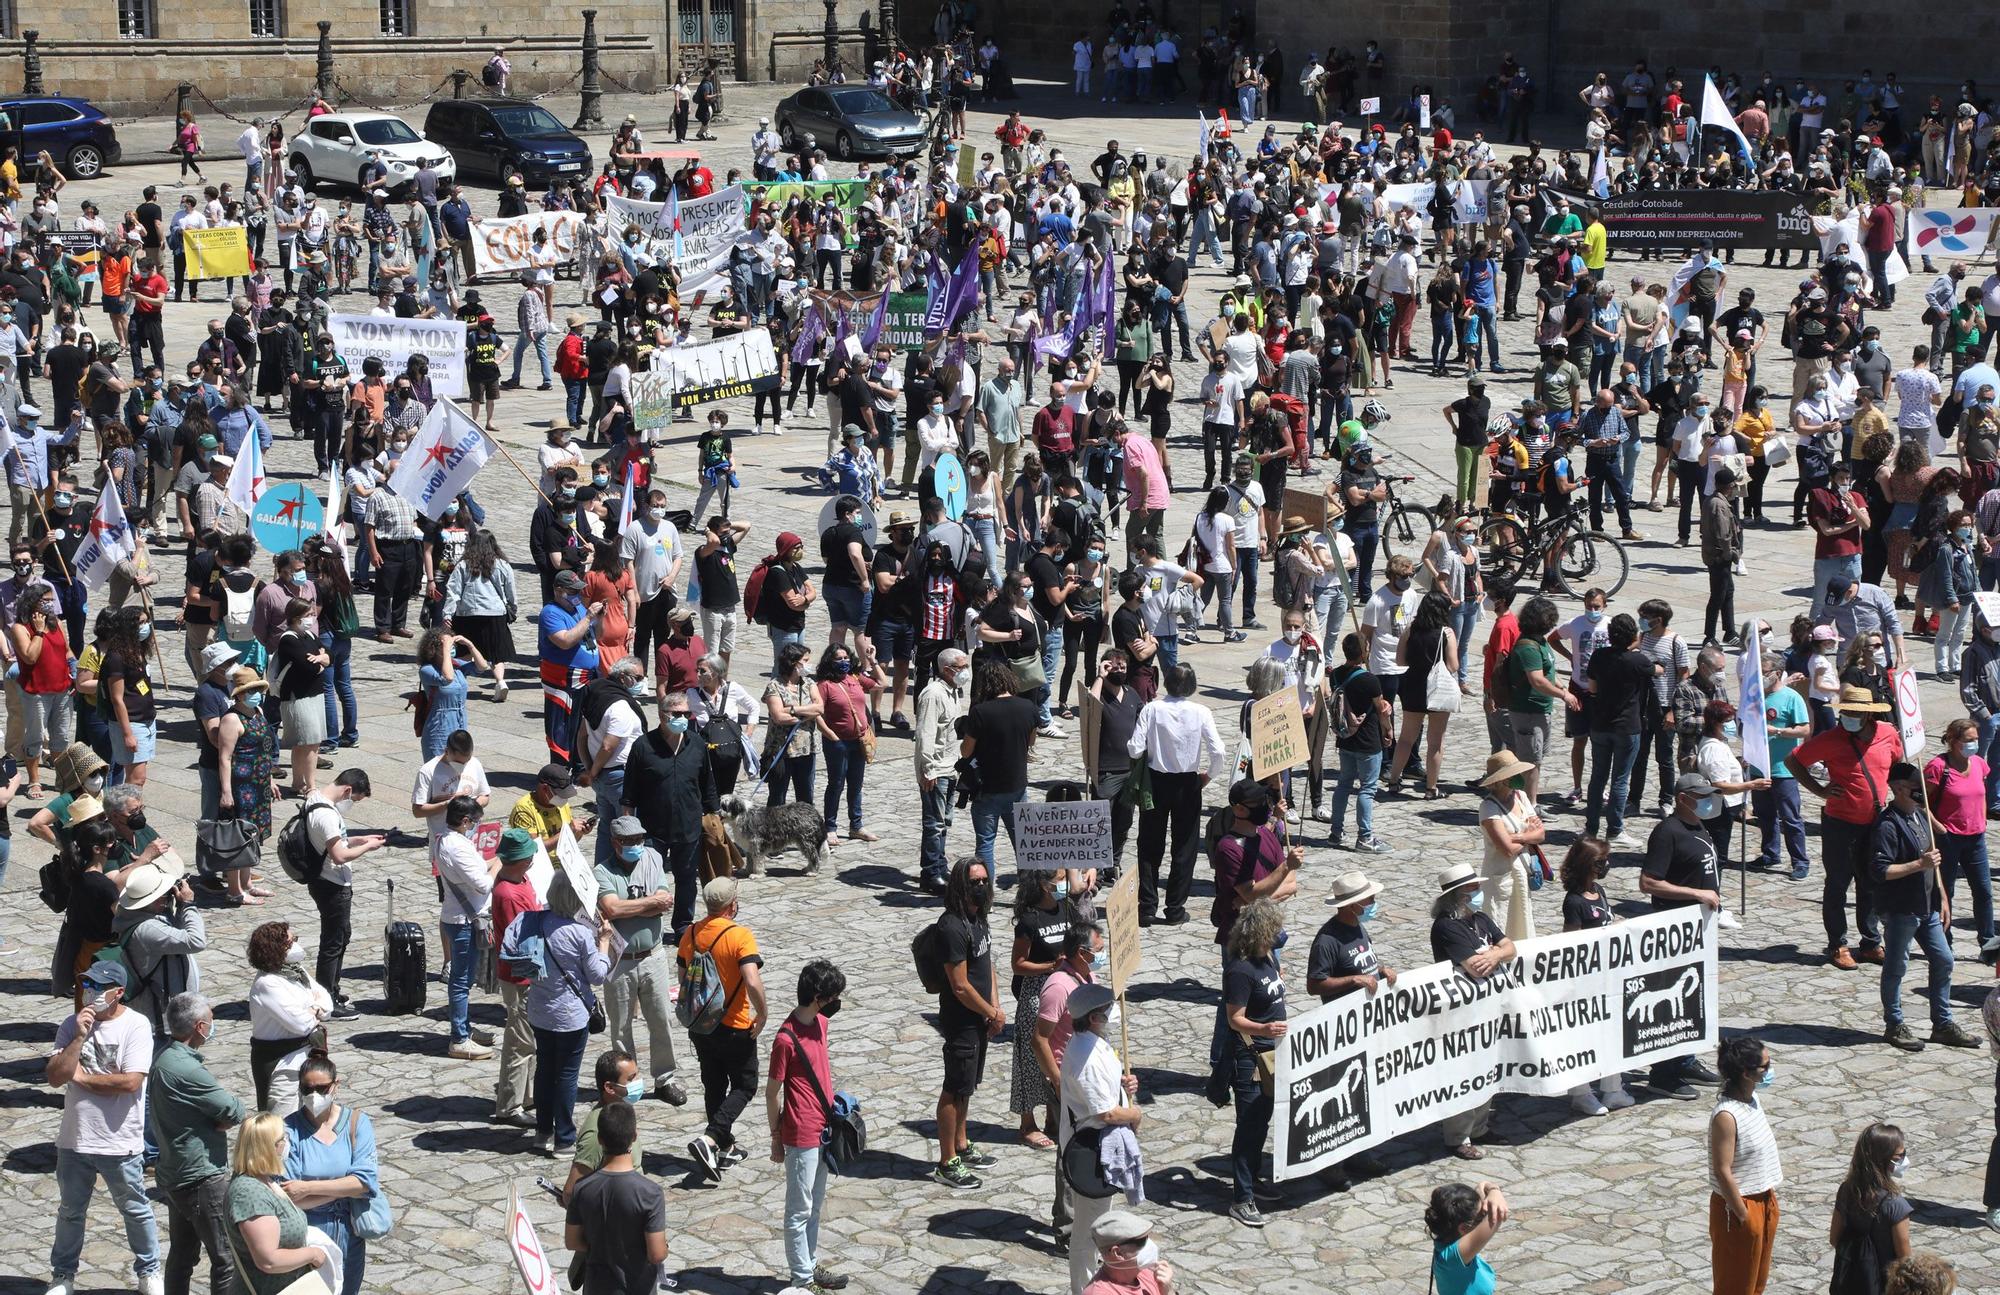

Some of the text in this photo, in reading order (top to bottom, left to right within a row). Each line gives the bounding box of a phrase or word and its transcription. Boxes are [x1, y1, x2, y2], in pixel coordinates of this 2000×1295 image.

[682, 200, 737, 222] PRESENTE
[1465, 204, 1487, 217] bng
[692, 218, 730, 237] ALDEAS
[1776, 212, 1810, 235] bng
[1619, 230, 1657, 239] ESPOLIO,
[1659, 230, 1675, 238] NIN
[885, 313, 899, 326] DA
[904, 313, 925, 326] TER
[344, 320, 458, 350] NON NON
[878, 331, 925, 344] ENOVAB
[344, 345, 391, 359] EÓLICOS
[425, 349, 456, 358] TENSIÓN
[476, 343, 495, 352] NON
[430, 362, 447, 370] OSA
[681, 393, 699, 406] NON
[714, 383, 753, 400] EÓLICOS
[255, 512, 288, 527] GALIZA
[858, 522, 873, 532] OVA
[1258, 707, 1271, 720] ESTA
[1036, 806, 1079, 822] VEÑEN
[1084, 807, 1100, 819] OS
[1030, 838, 1100, 850] VENDERNOS
[1626, 977, 1646, 994] SOS
[1289, 1020, 1329, 1070] NON
[1334, 1006, 1358, 1051] AO
[1363, 981, 1442, 1038] PARQUE
[1532, 941, 1602, 985] SERRA
[1609, 933, 1634, 970] DA
[1640, 919, 1705, 963] GROBA
[1375, 1037, 1436, 1085] ESPAZO
[1530, 994, 1611, 1038] CULTURAL
[1633, 1043, 1645, 1055] NON
[1644, 1041, 1653, 1050] AO
[1654, 1035, 1676, 1048] PARQUE
[1292, 1077, 1312, 1099] SOS
[1395, 1048, 1597, 1118] www.sosgroba.com
[1300, 1149, 1315, 1161] NON
[1314, 1145, 1322, 1155] AO
[1322, 1136, 1347, 1152] PARQUE
